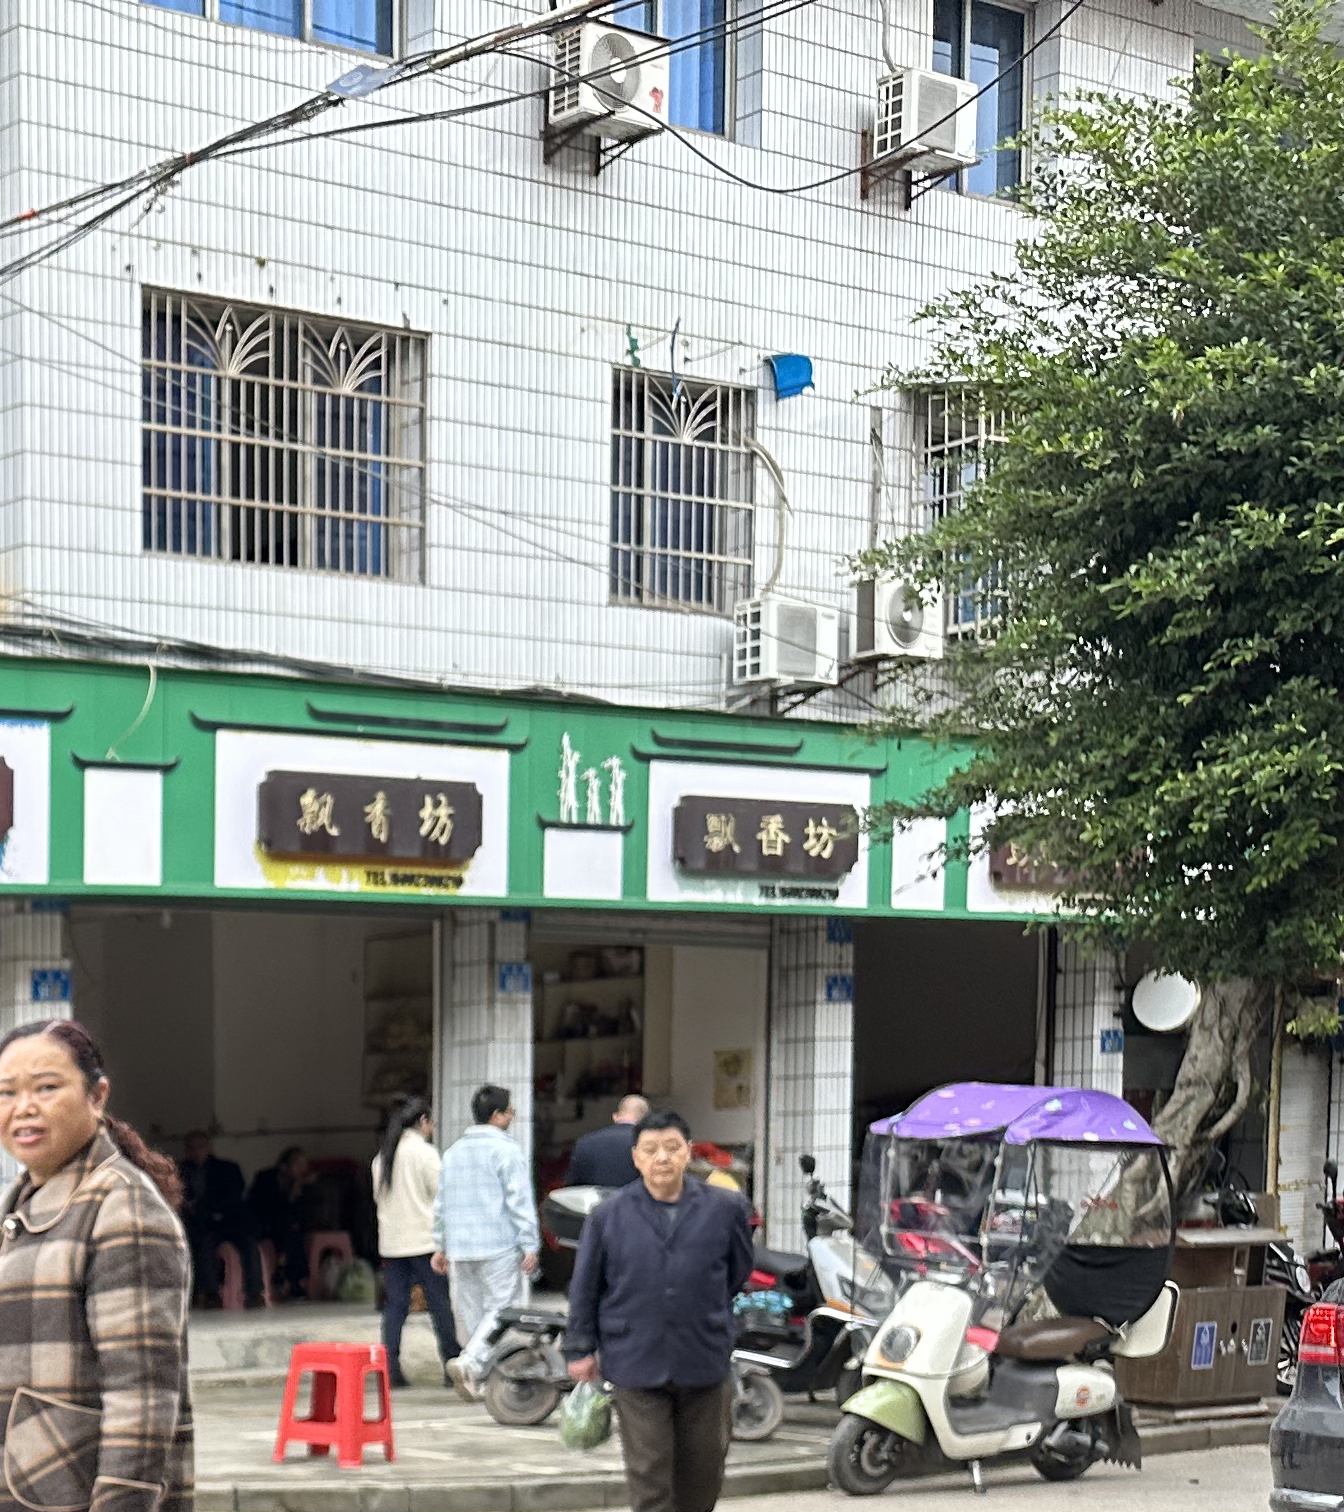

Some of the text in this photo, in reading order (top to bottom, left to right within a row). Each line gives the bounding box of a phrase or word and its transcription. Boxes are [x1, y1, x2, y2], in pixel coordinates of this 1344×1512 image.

[296, 787, 456, 847] 飘香坊
[703, 812, 838, 860] 飘香坊
